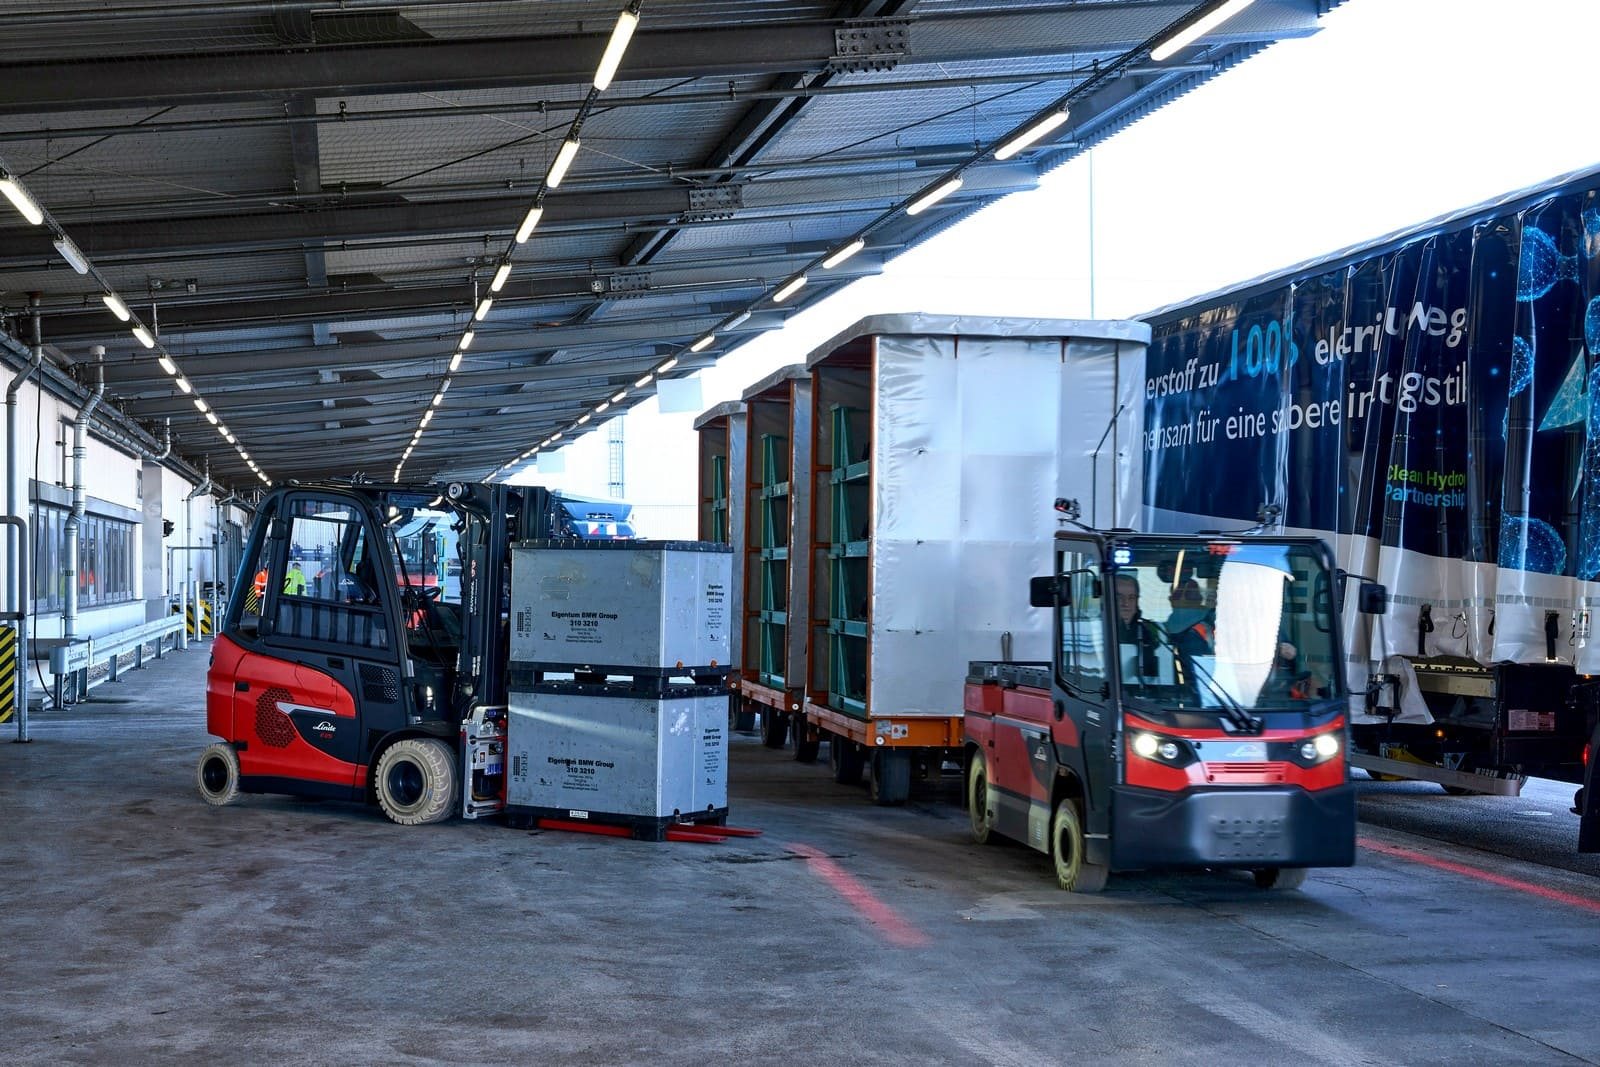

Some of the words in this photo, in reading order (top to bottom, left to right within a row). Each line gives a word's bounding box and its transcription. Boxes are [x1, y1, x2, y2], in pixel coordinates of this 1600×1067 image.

[1198, 362, 1219, 389] zu
[1197, 409, 1220, 443] für
[1226, 406, 1266, 440] eine
[1387, 464, 1423, 485] Clean
[551, 611, 580, 620] Eigentum
[598, 613, 618, 621] Group
[595, 761, 615, 769] Group
